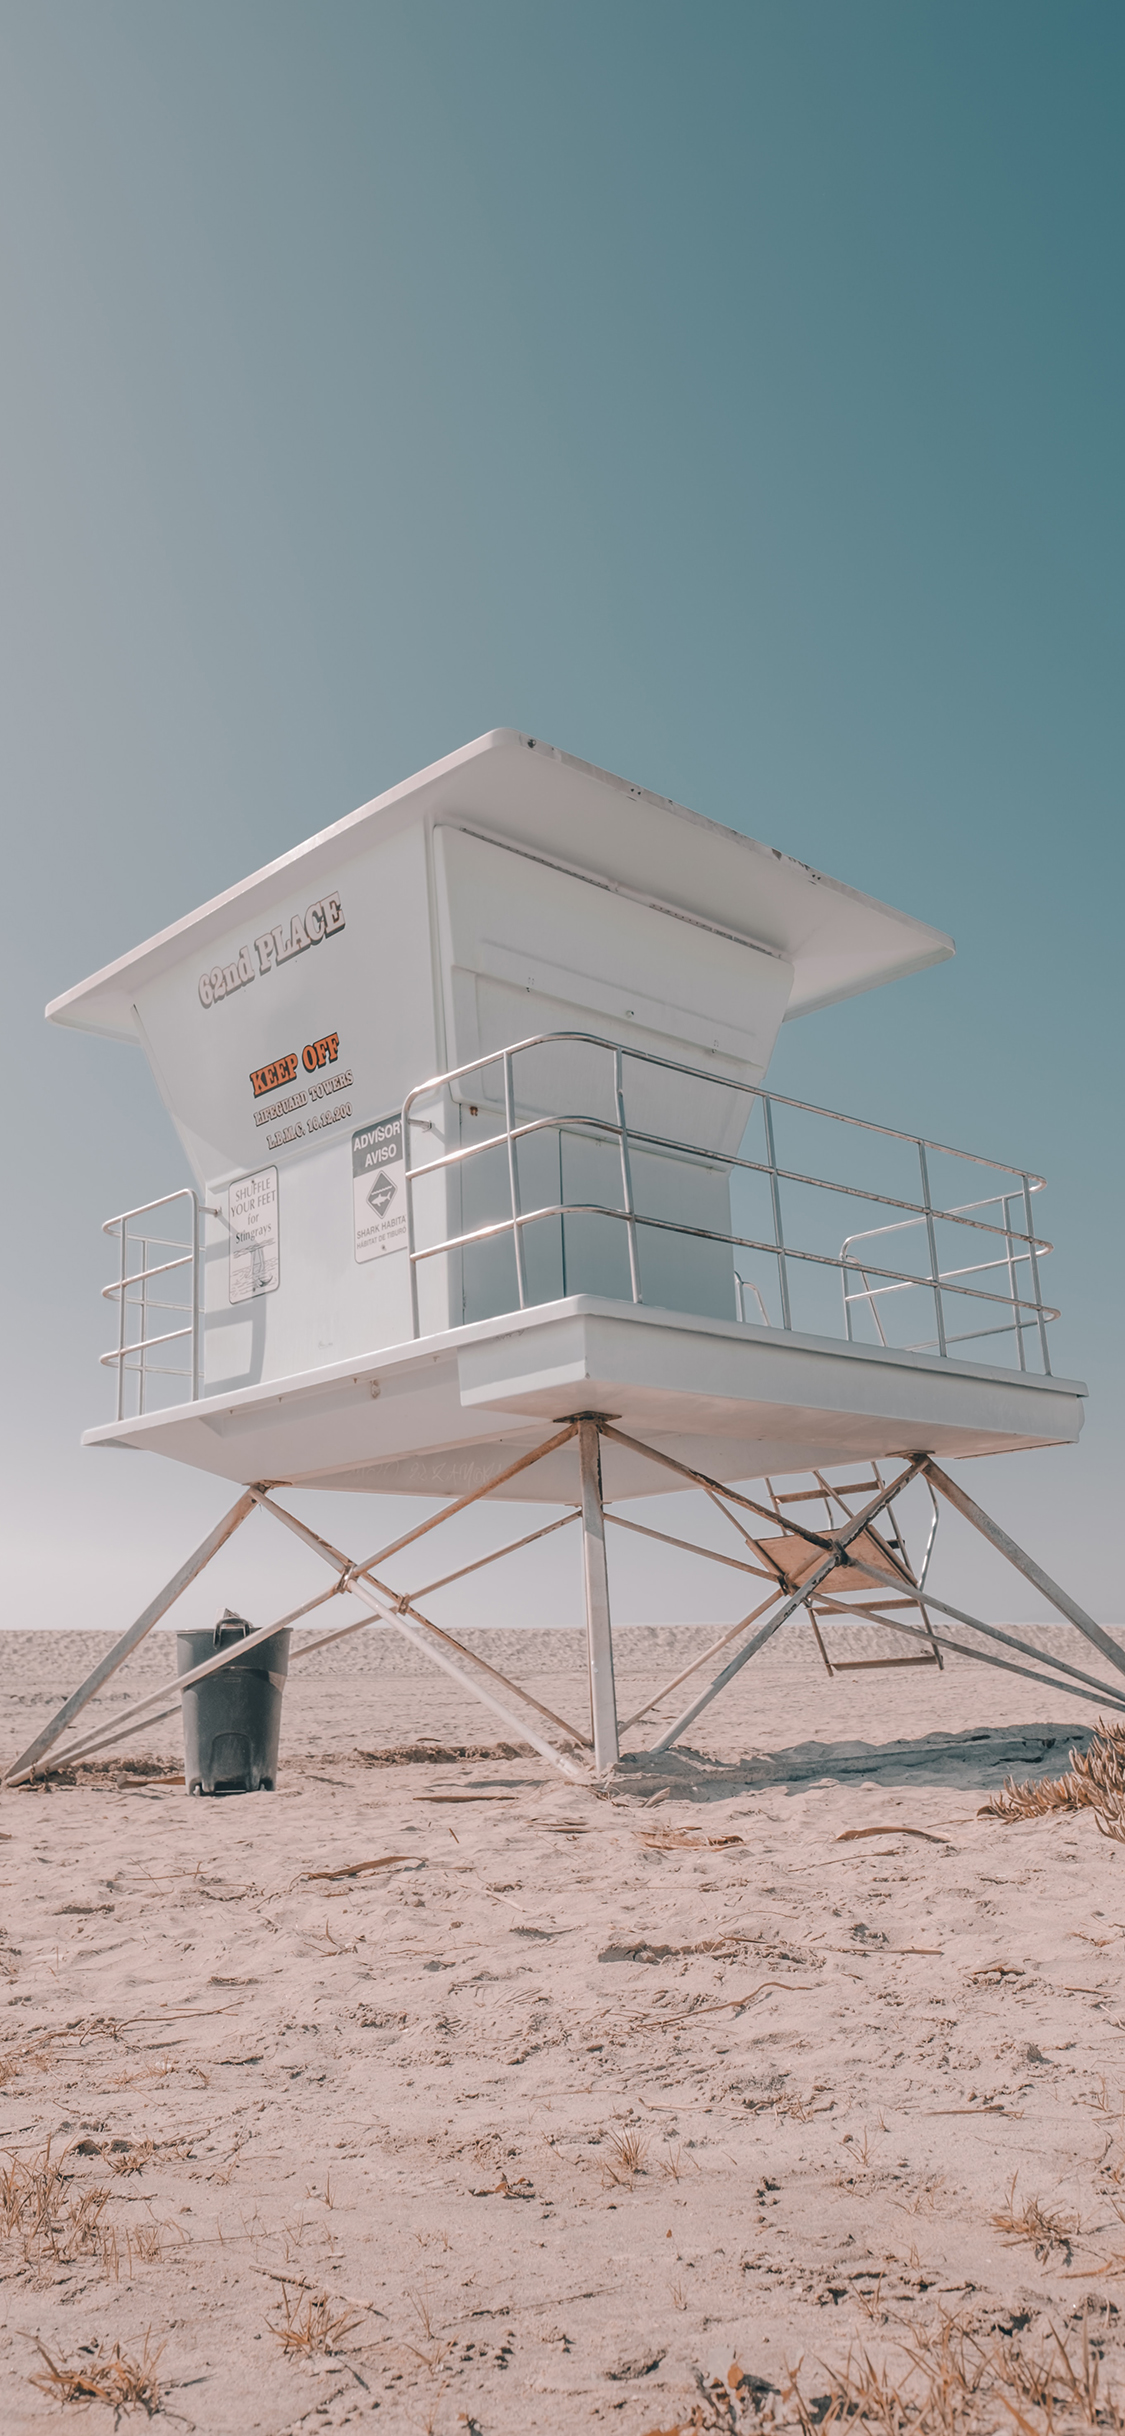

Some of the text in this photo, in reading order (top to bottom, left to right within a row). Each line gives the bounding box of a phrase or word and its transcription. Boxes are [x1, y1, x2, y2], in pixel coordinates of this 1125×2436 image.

[198, 891, 346, 1009] 62nd PLACE
[249, 1032, 340, 1099] KEEP OFF
[253, 1069, 354, 1127] LIFEGUARD TOWERS
[365, 1143, 397, 1168] AVISO
[235, 1177, 271, 1202] SHUFFLE
[230, 1190, 276, 1217] YOUR FEET
[247, 1213, 259, 1225] for
[356, 1214, 407, 1240] SHARK HABITA
[235, 1223, 272, 1244] Stingrays
[378, 1233, 386, 1242] DE
